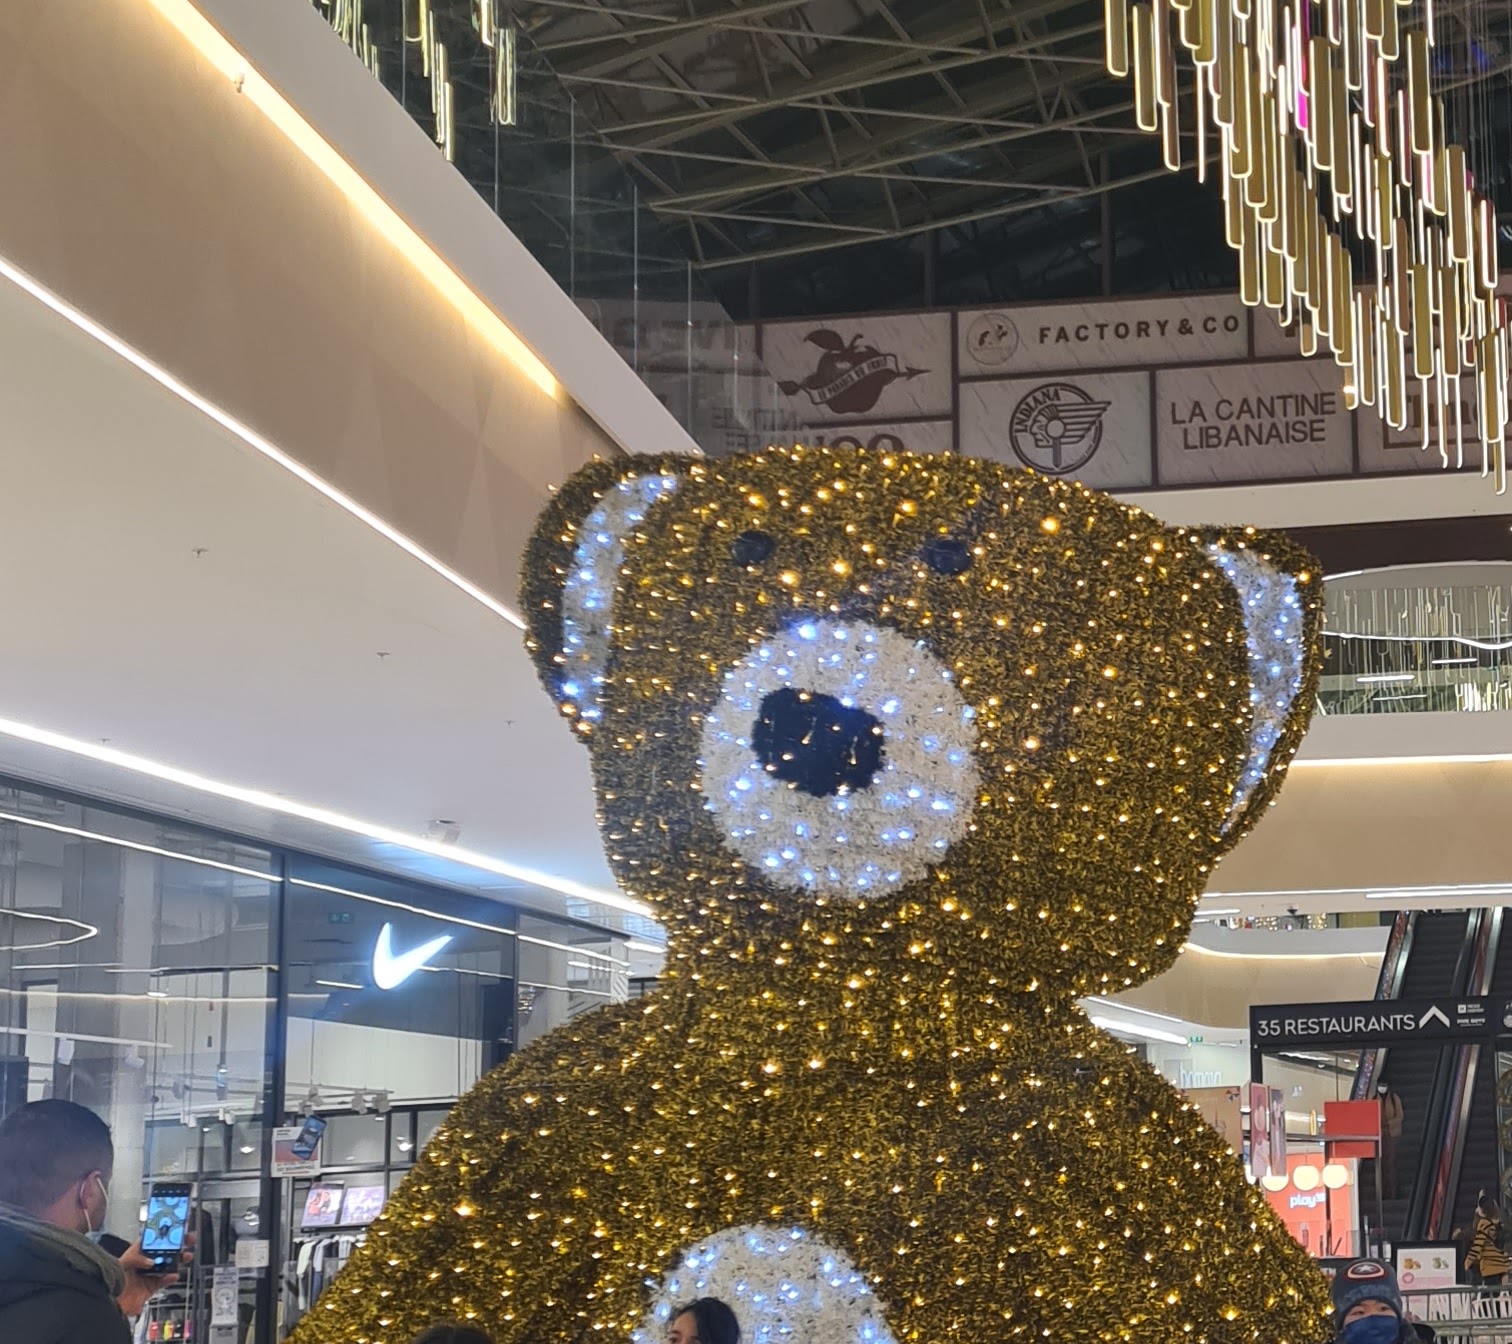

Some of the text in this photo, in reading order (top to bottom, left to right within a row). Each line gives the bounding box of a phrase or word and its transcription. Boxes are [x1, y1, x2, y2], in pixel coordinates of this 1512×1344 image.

[1039, 319, 1170, 344] FACTORY
[1203, 315, 1239, 334] CO
[1014, 387, 1061, 434] INDIANA
[1171, 391, 1337, 425] LA CANTINE
[1184, 418, 1327, 450] LIBANAISE
[1257, 1013, 1416, 1036] 35 RESTAURANTS
